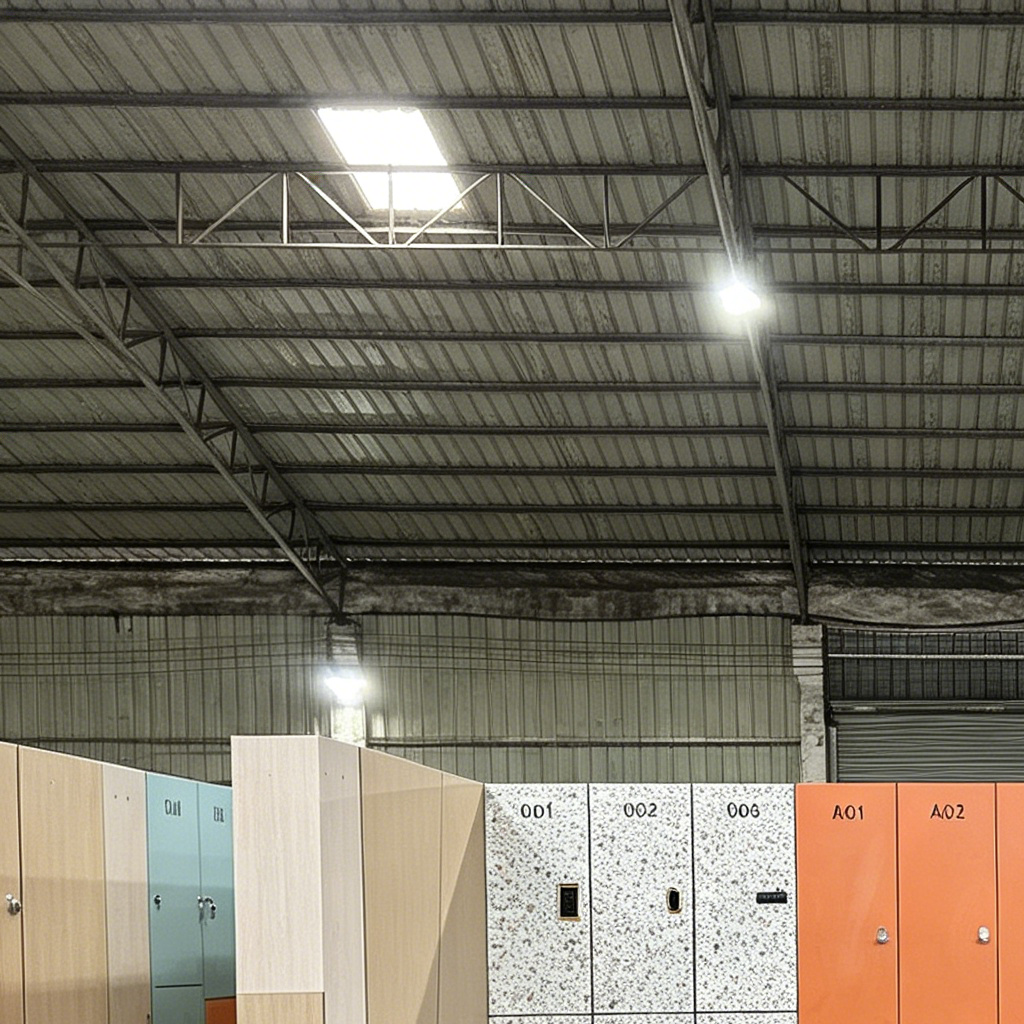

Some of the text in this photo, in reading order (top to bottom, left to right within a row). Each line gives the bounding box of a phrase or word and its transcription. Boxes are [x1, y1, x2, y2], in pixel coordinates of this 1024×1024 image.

[521, 801, 553, 818] 001
[623, 802, 658, 818] 002
[832, 804, 865, 820] A01
[930, 804, 965, 820] A02
